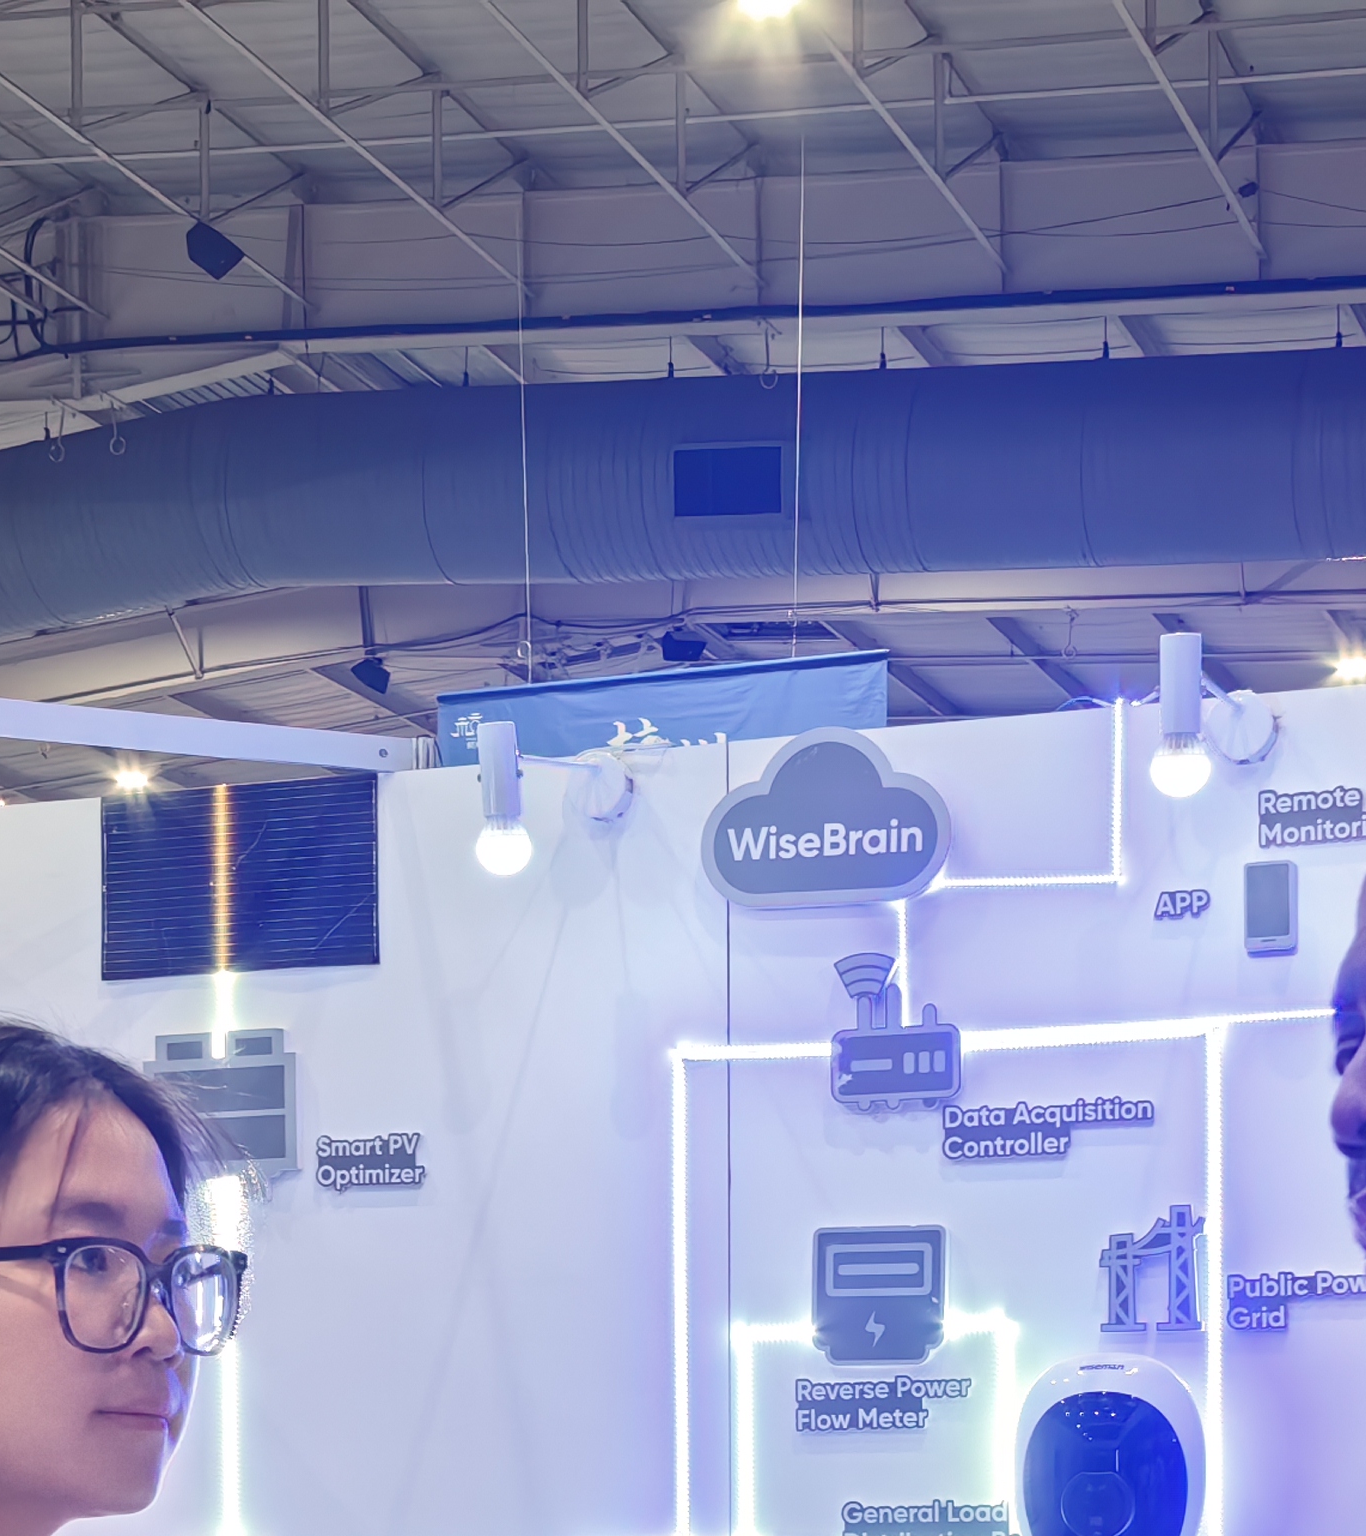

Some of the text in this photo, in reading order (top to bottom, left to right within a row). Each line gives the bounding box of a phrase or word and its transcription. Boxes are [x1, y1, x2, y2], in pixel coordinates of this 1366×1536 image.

[1260, 787, 1361, 815] Remote
[727, 819, 923, 861] WiseBrain
[1157, 890, 1208, 917] APP
[944, 1097, 1153, 1130] Data Acquisition
[317, 1134, 419, 1156] Smart PV
[944, 1131, 1069, 1159] Controller
[317, 1164, 424, 1190] Optimizer
[1228, 1274, 1309, 1298] Public
[1229, 1305, 1285, 1328] Grid
[797, 1376, 970, 1401] Reverse Power
[797, 1407, 928, 1431] Flow Meter
[842, 1500, 1009, 1525] General Load
